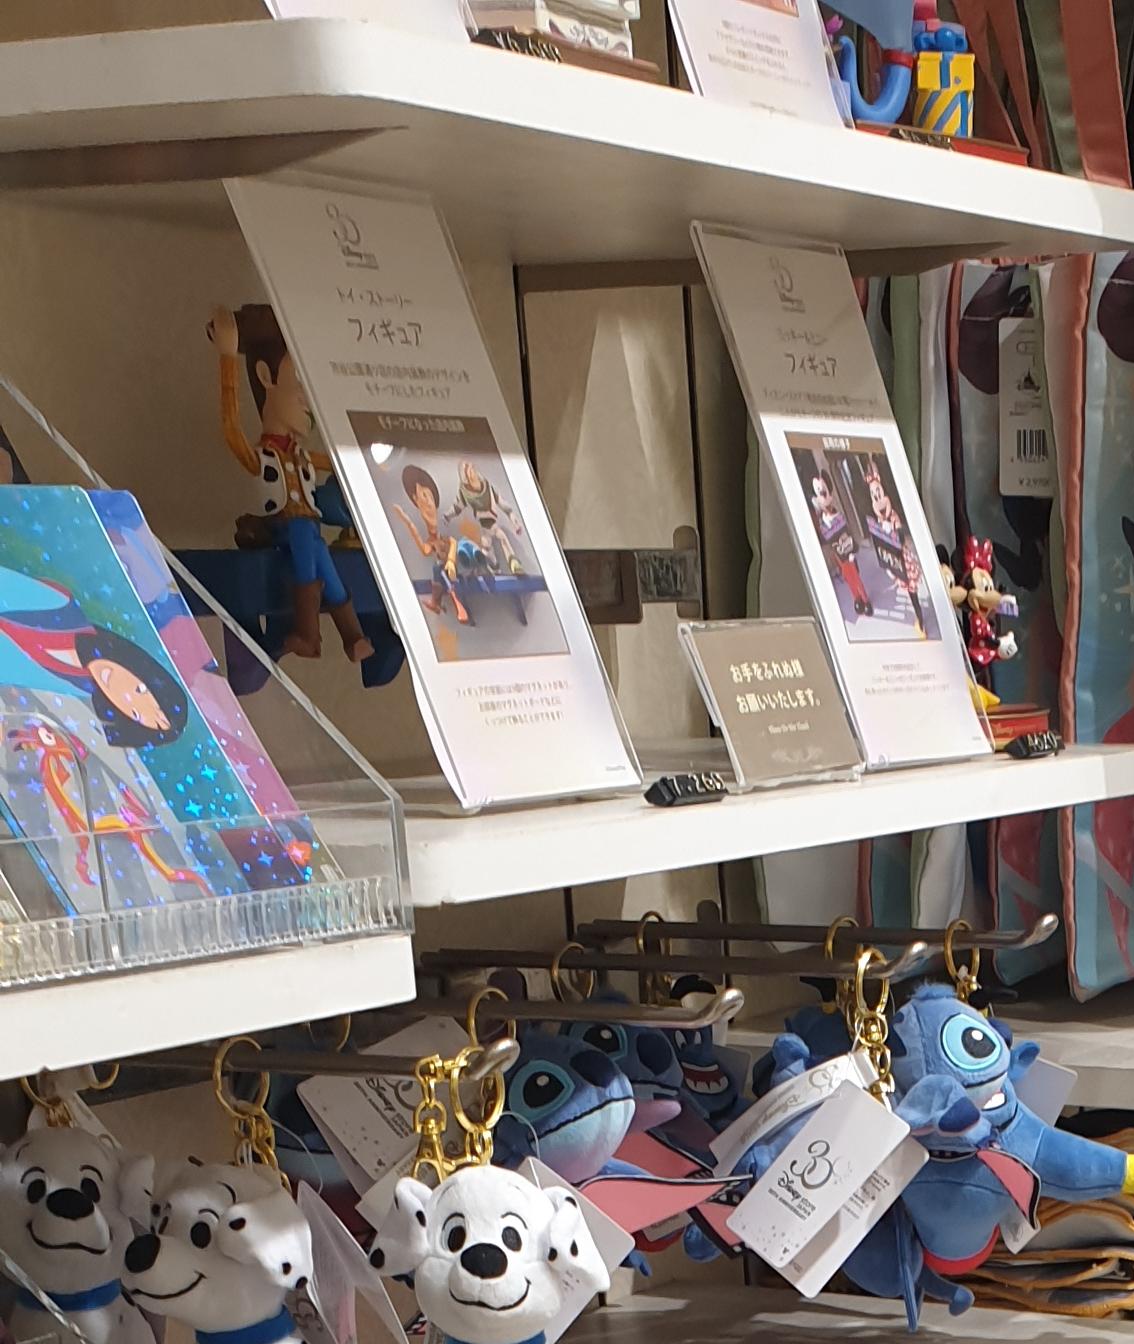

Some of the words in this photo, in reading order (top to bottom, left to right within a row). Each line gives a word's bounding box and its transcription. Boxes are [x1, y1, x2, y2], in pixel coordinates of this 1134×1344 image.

[347, 318, 422, 347] フィギュア
[784, 353, 838, 377] フィギュア
[730, 658, 805, 684] お手をふれぬ様
[735, 688, 822, 714] お願いいたします。
